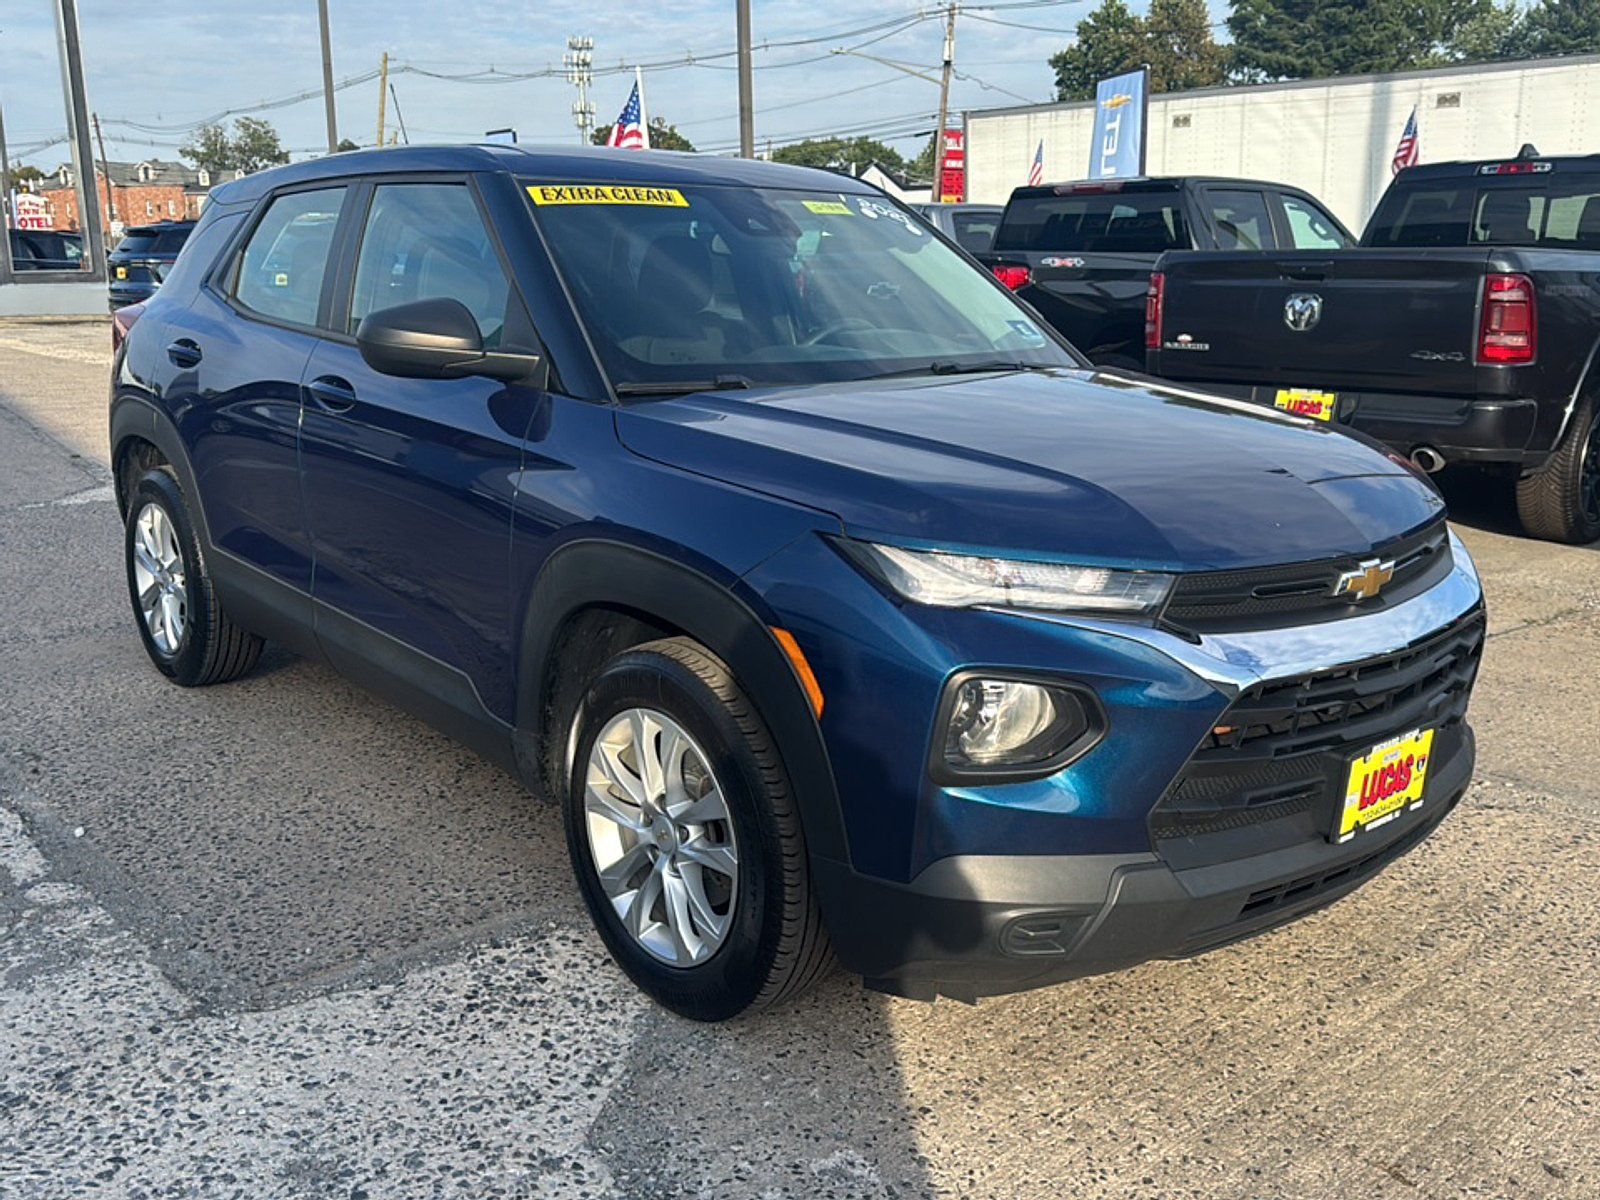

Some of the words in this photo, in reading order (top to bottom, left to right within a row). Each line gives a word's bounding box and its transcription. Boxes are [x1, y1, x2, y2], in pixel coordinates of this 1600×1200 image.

[540, 187, 609, 201] EXTRA
[611, 188, 676, 203] CLEAN
[19, 216, 53, 229] OTEL
[1286, 399, 1323, 416] LUCAS
[1358, 753, 1415, 811] LUCAS
